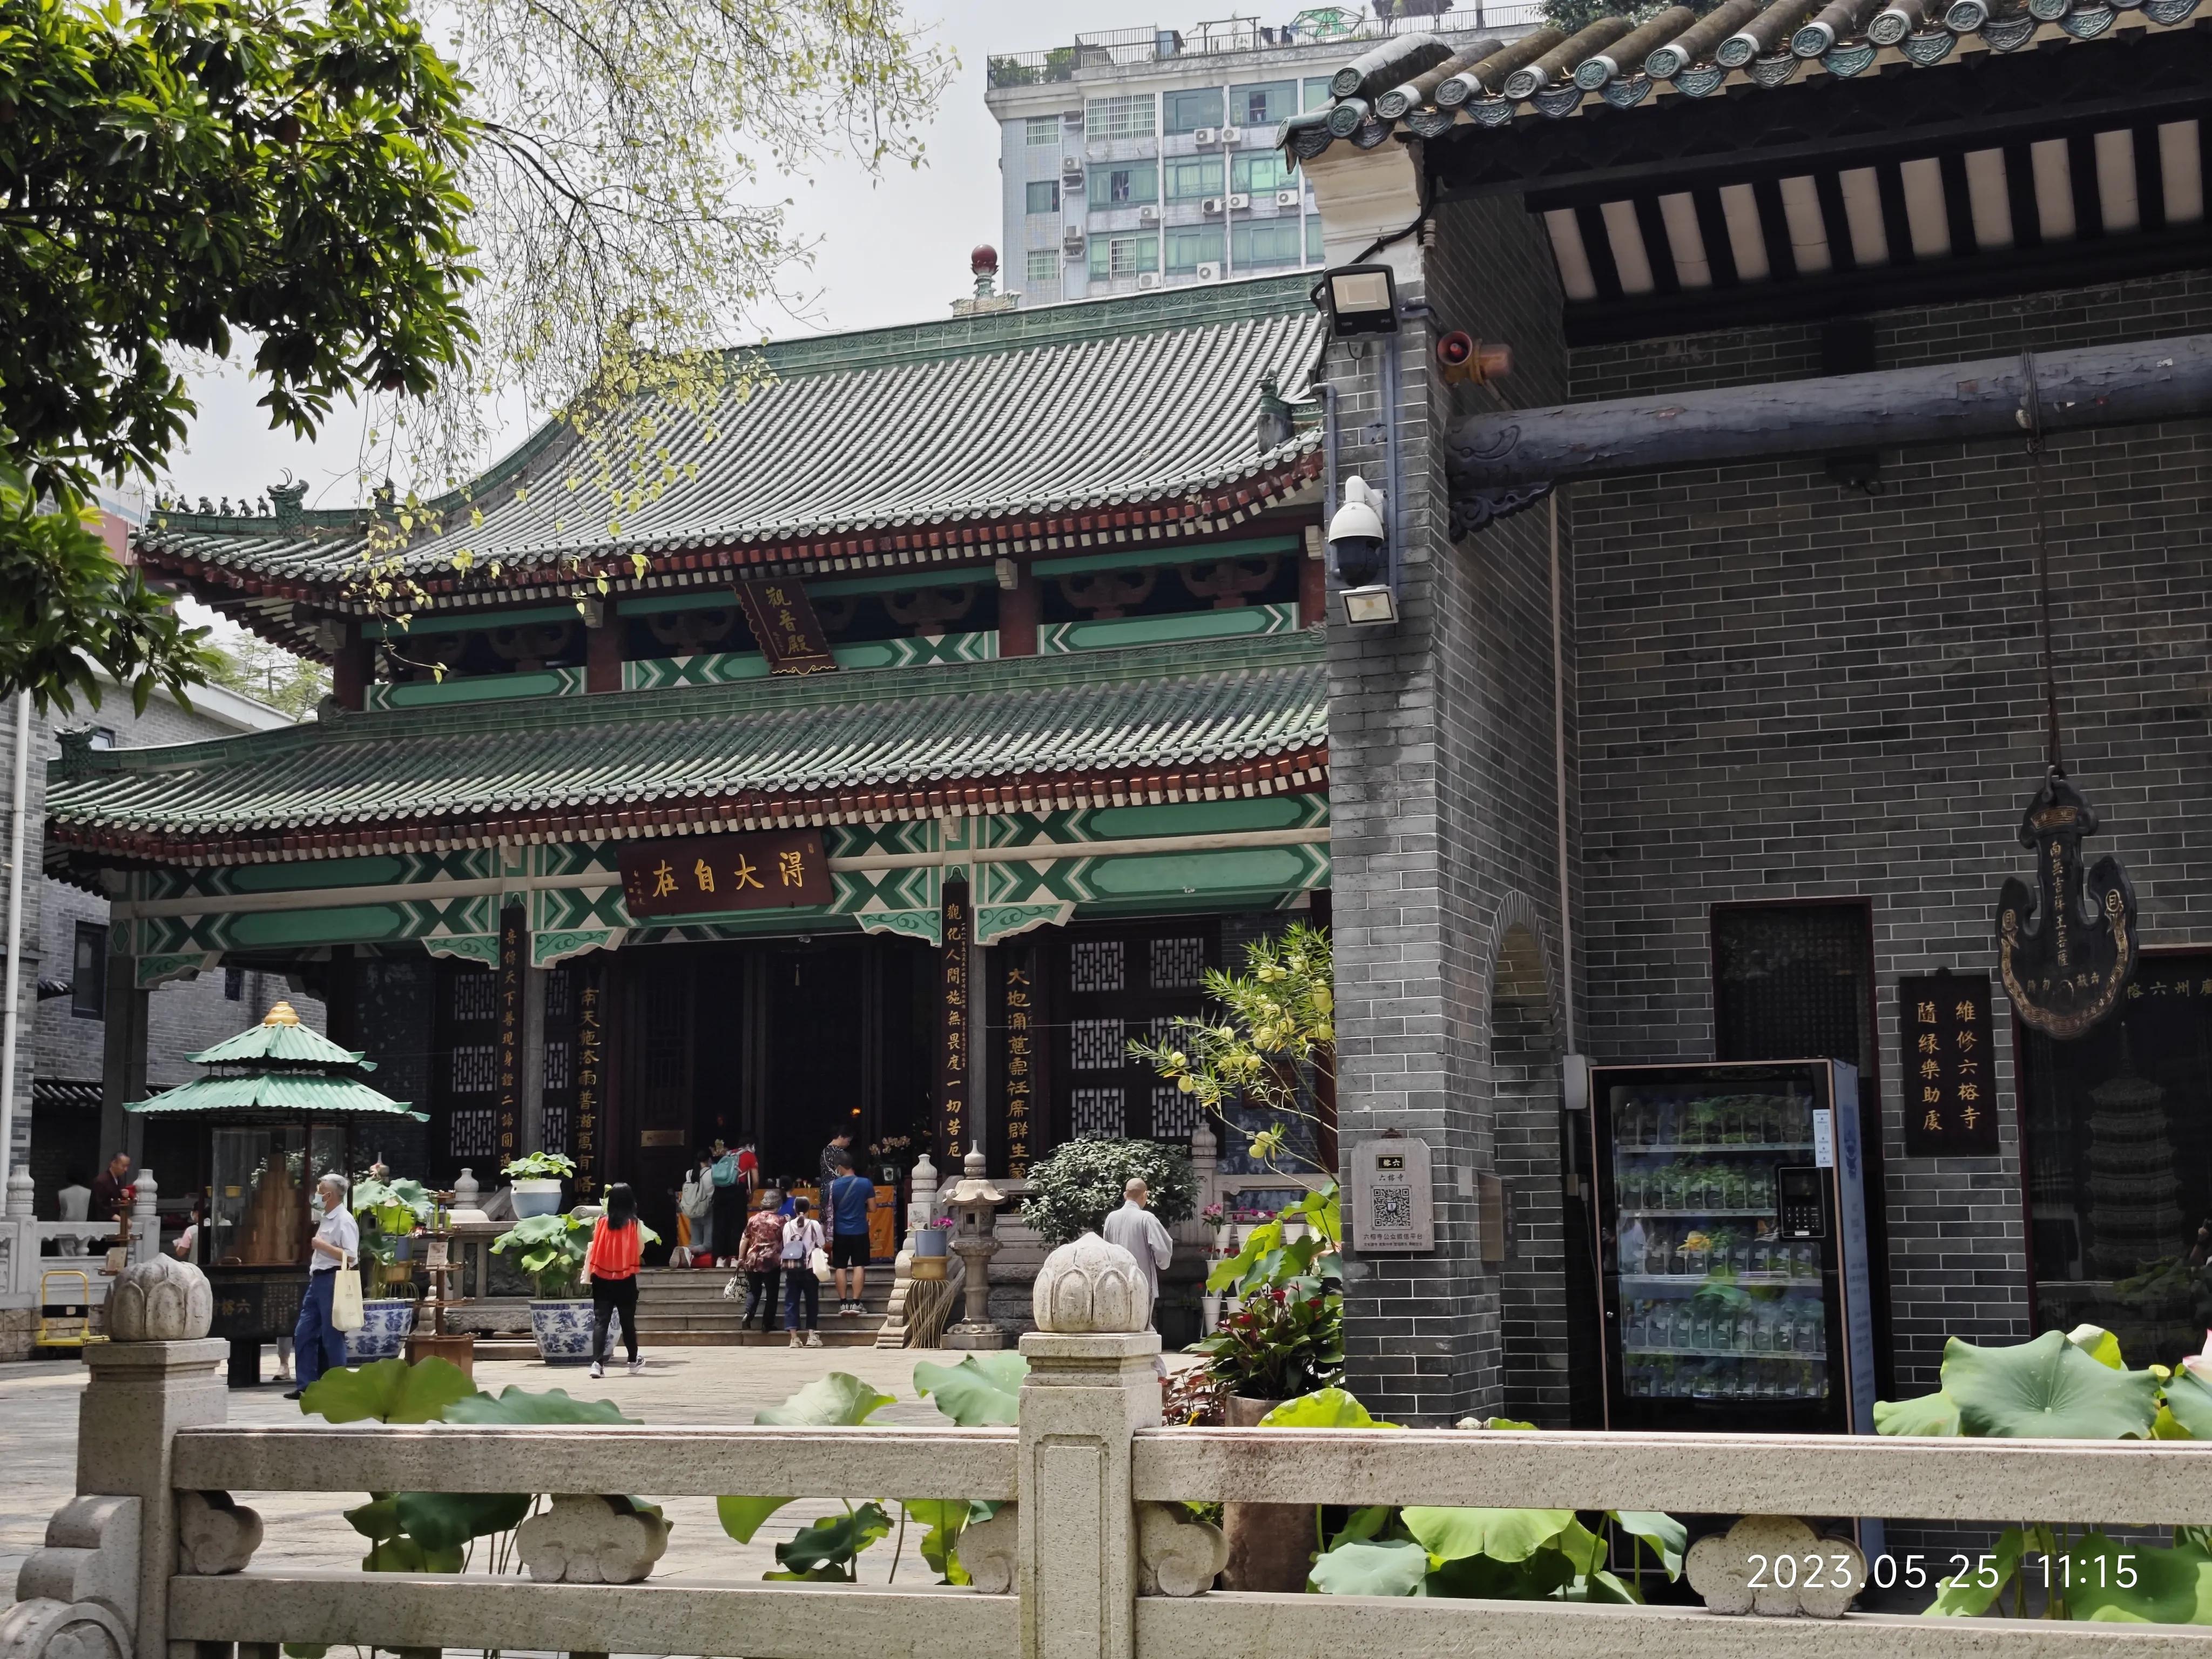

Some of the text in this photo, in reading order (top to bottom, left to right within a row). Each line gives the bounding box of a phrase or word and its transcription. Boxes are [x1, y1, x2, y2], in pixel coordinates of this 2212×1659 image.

[765, 586, 814, 655] 觀音殿
[946, 903, 962, 1158] 觀化人間施無畏度一切苦厄
[1955, 1000, 1981, 1130] 維修六榕寺
